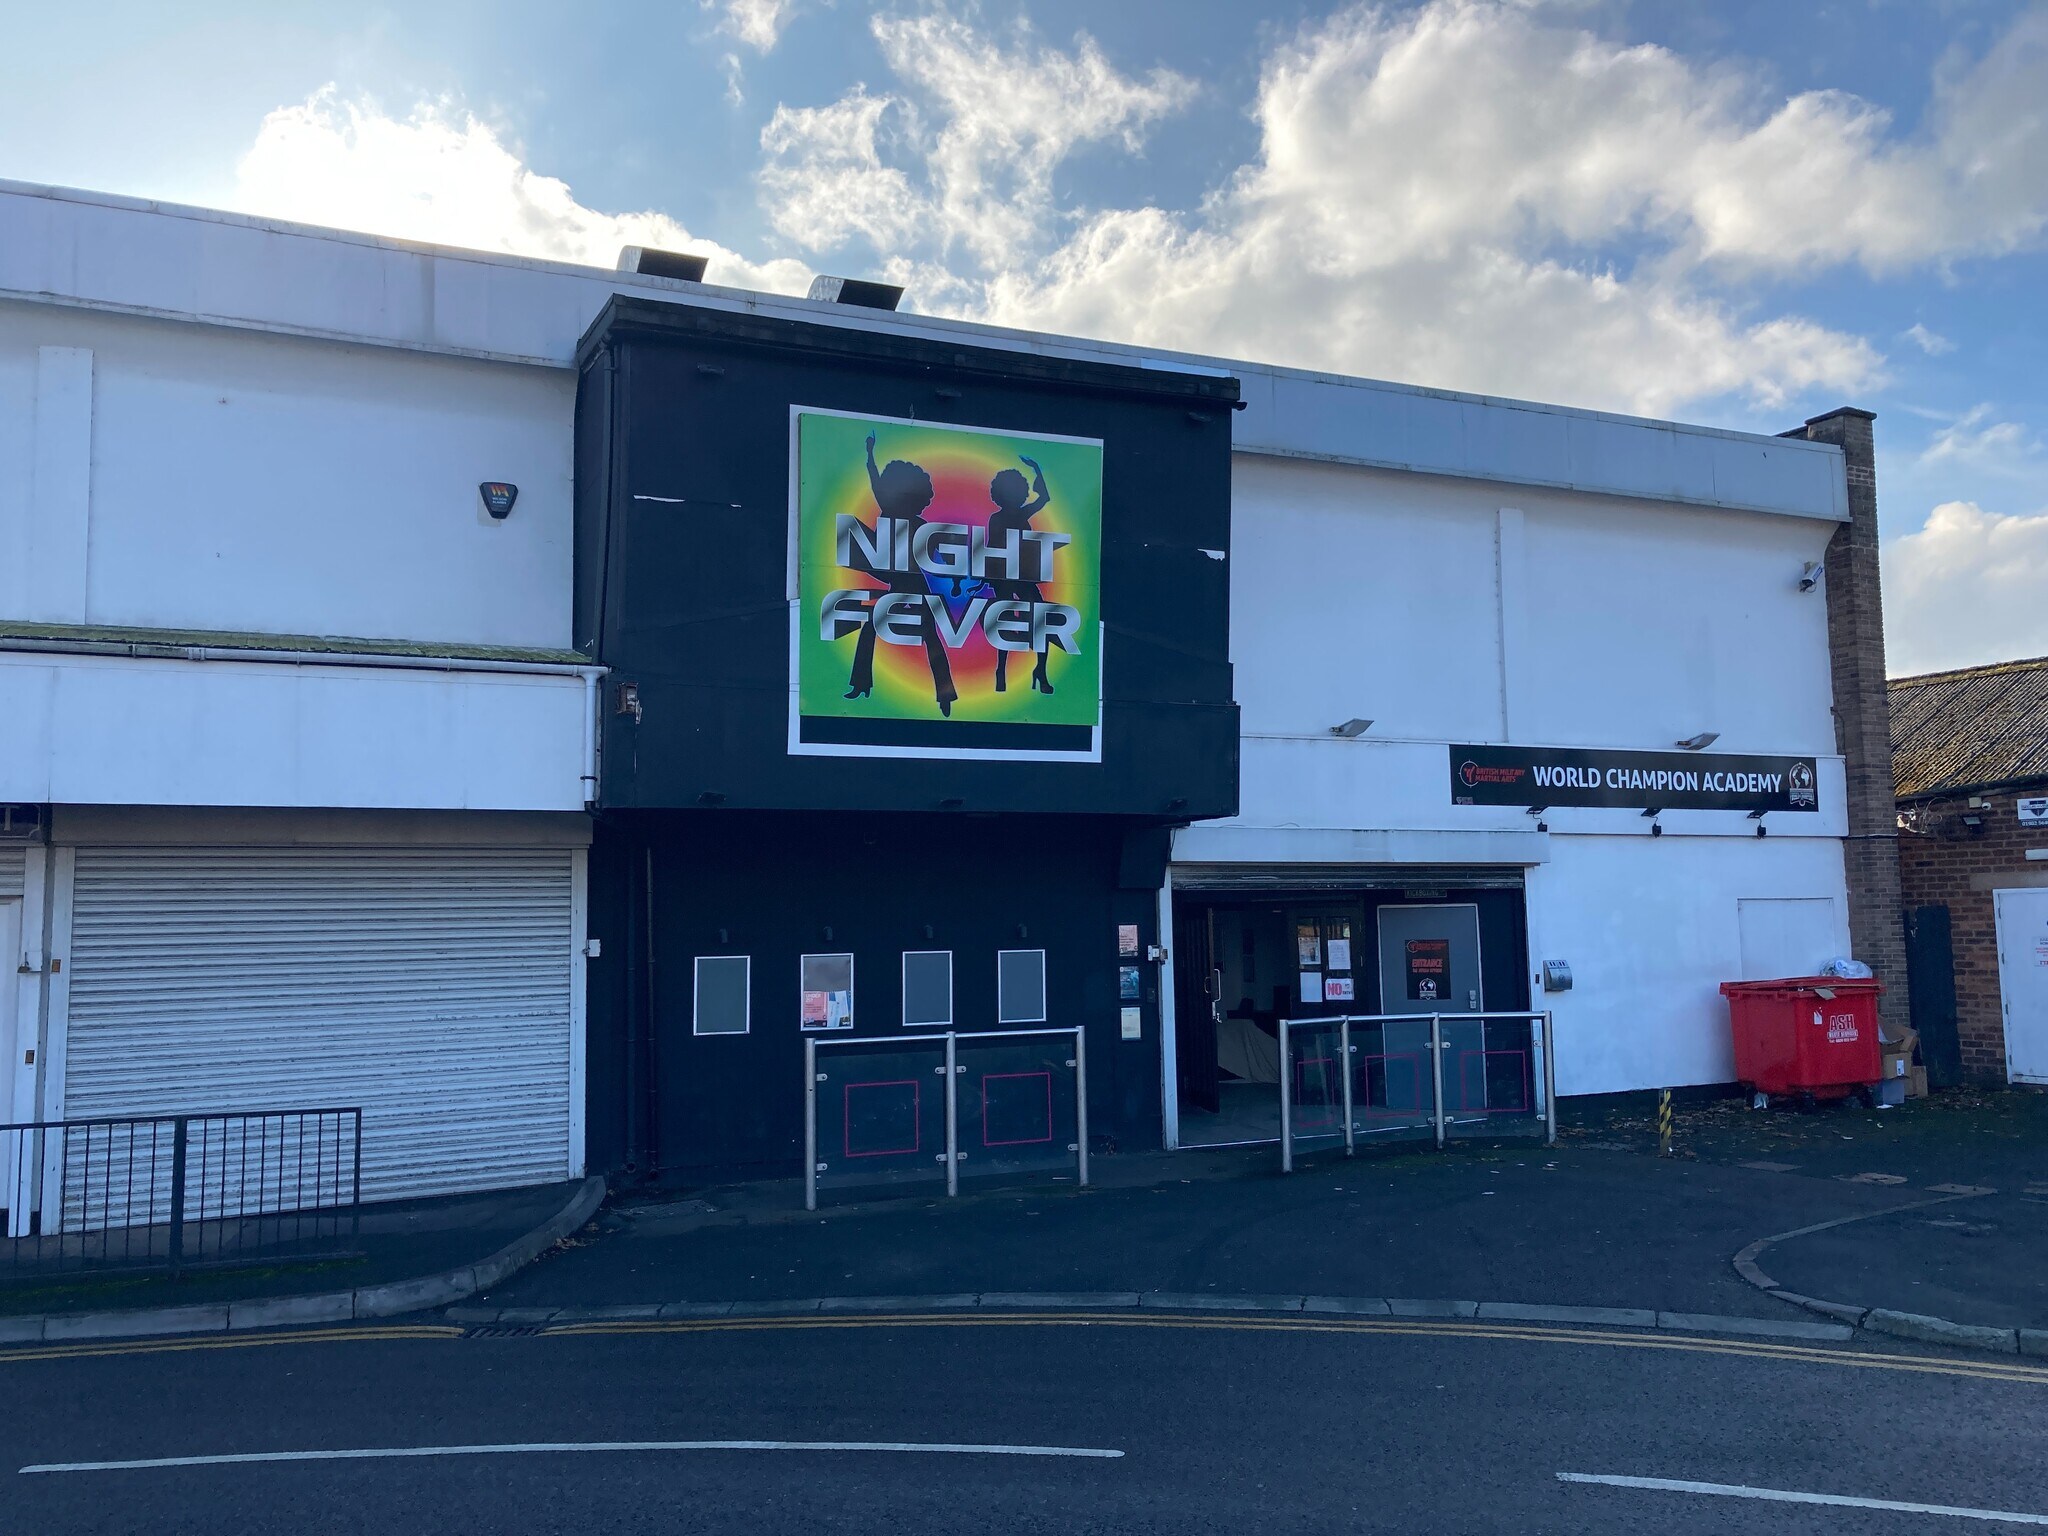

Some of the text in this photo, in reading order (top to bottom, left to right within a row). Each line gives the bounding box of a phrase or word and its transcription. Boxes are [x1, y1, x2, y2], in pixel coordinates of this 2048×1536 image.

[834, 512, 1073, 584] NIGHT
[819, 588, 1083, 656] FEVER
[1532, 766, 1782, 793] WORLD CHAMPION ACADEMY
[1327, 982, 1343, 996] NO
[1830, 1014, 1856, 1031] ASH
